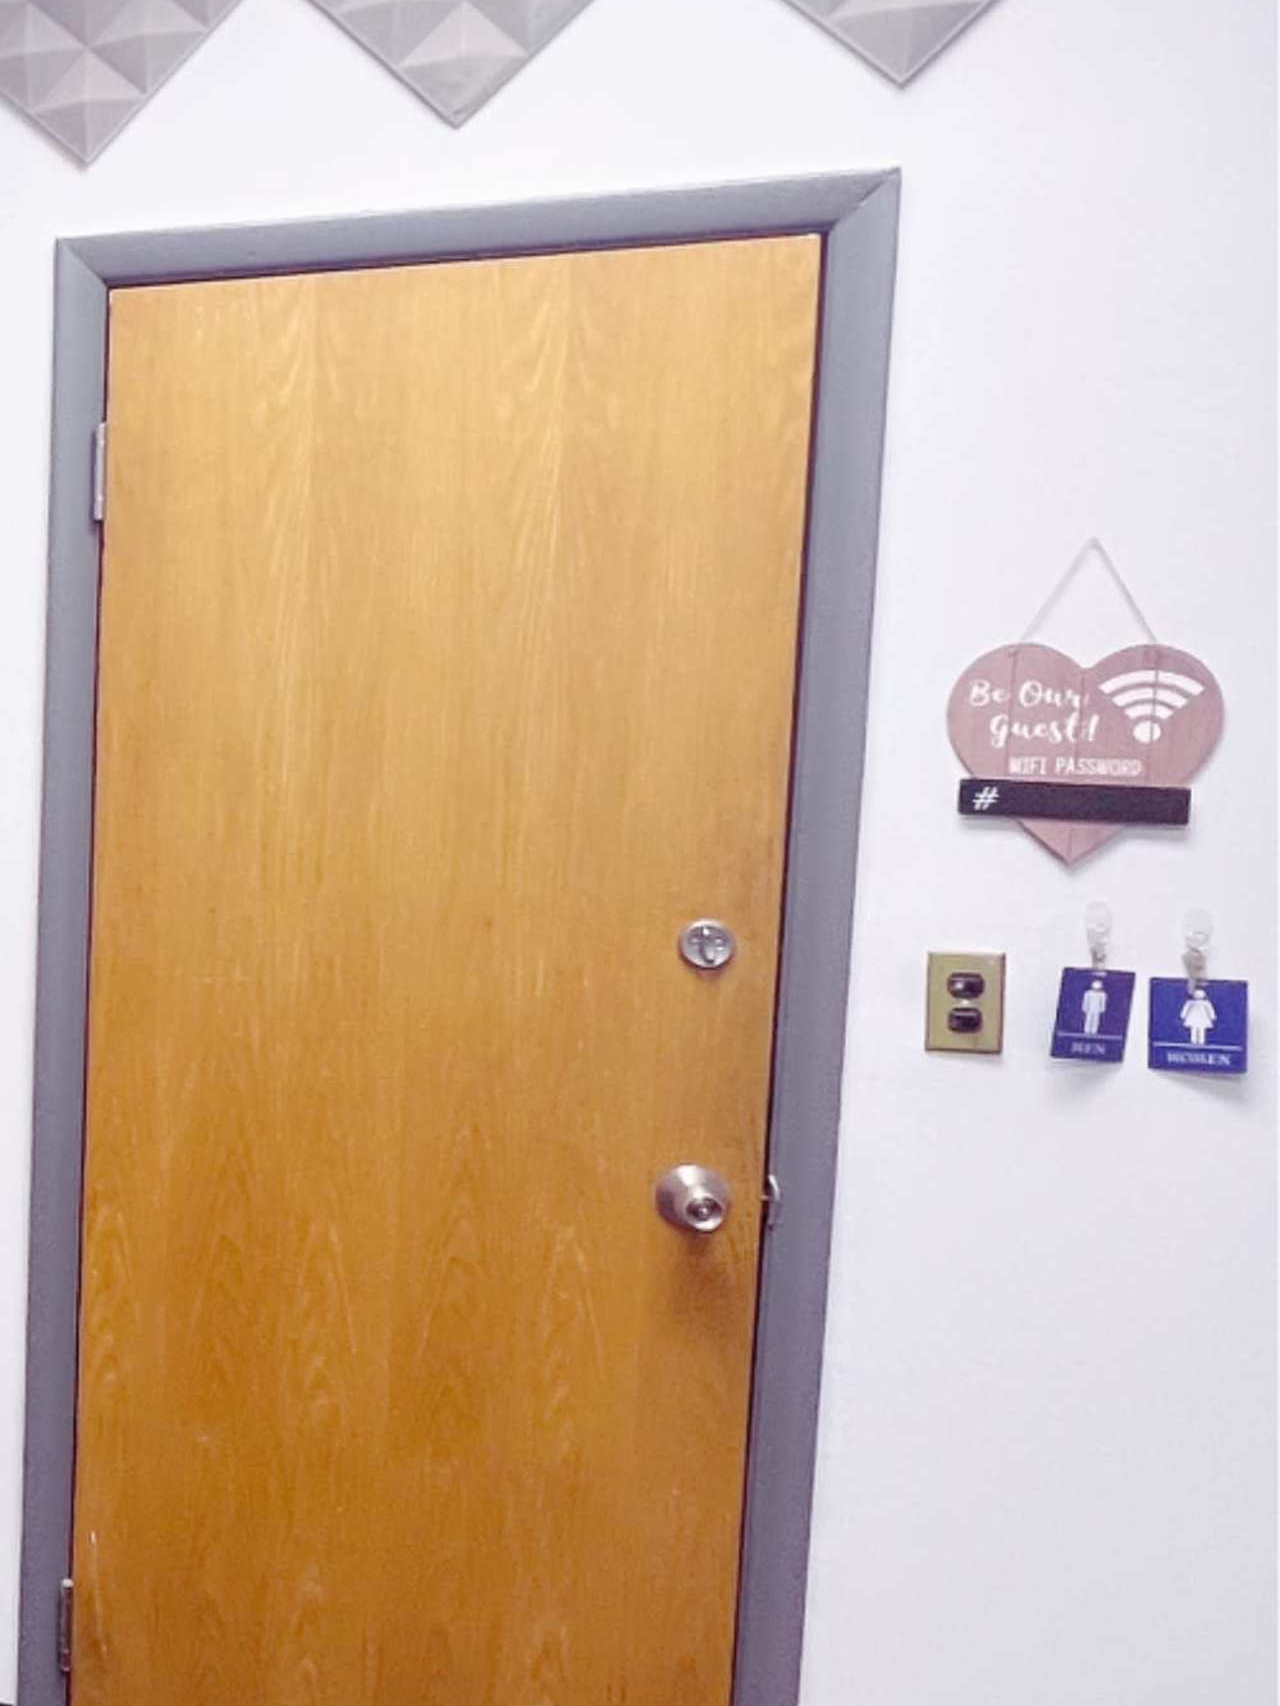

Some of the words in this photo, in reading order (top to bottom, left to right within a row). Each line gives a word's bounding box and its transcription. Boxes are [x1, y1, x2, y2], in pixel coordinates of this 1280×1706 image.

[969, 679, 1011, 707] Be
[1020, 679, 1089, 708] Our
[1009, 756, 1047, 775] WIFI
[1055, 756, 1143, 777] PASSWORD
[1071, 1041, 1107, 1056] MEN
[1166, 1051, 1232, 1066] WOMEN
